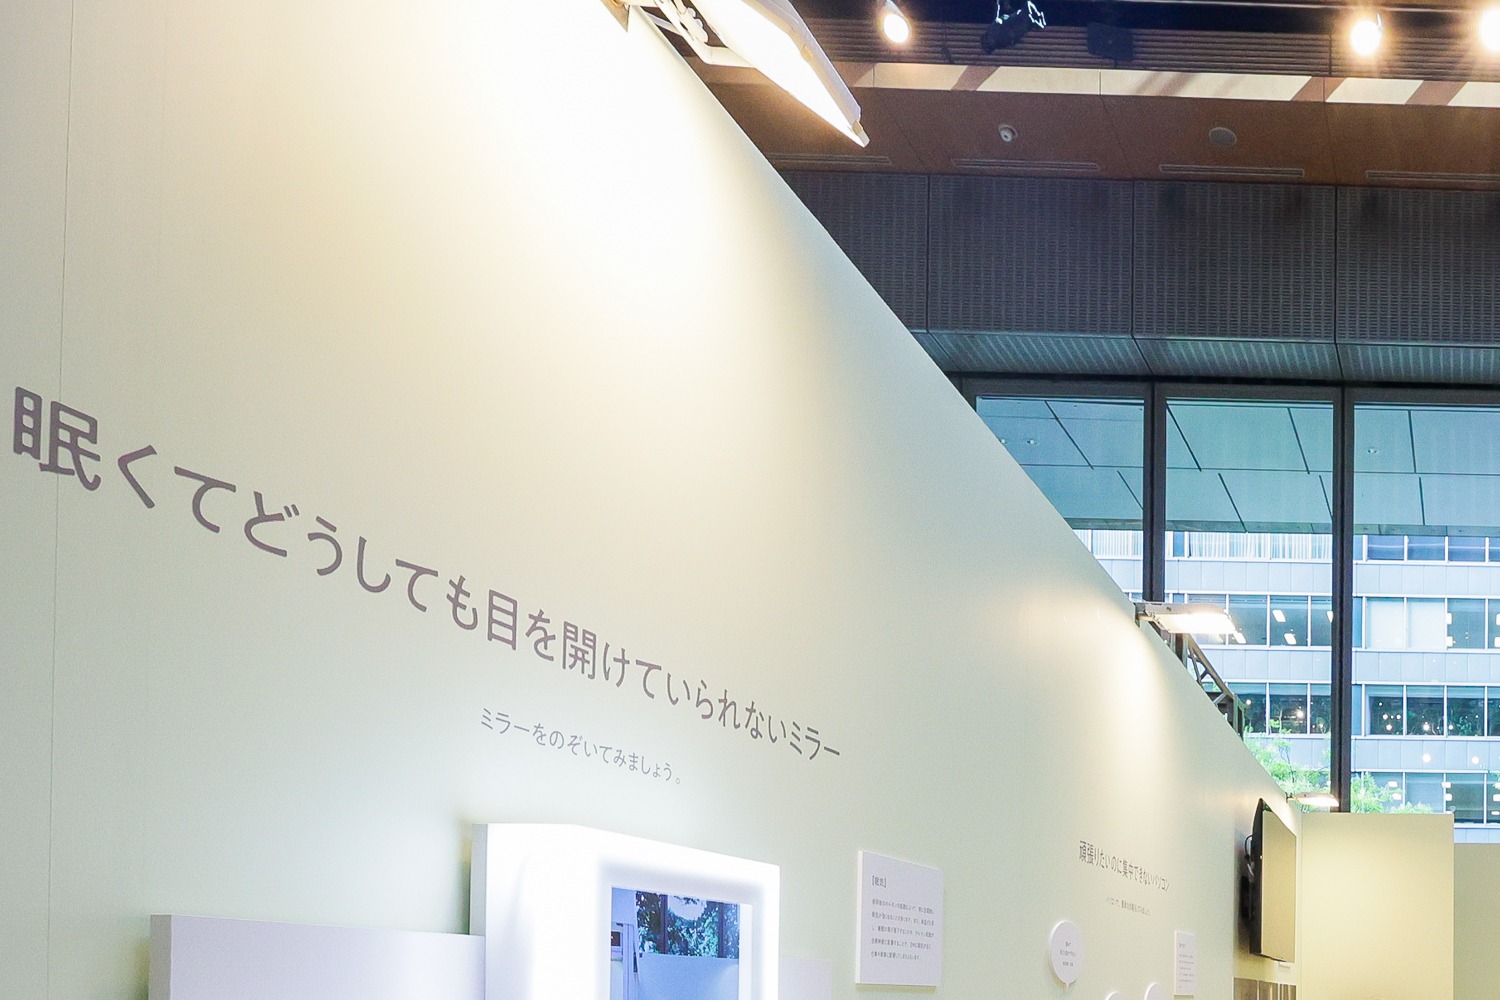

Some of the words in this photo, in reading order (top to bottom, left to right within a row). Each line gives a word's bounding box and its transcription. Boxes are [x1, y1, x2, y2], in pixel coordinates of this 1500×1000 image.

[13, 386, 842, 761] 眠くてどうしても目を開けていられないミラー
[480, 707, 683, 786] ミラーをのぞいてみましょう。
